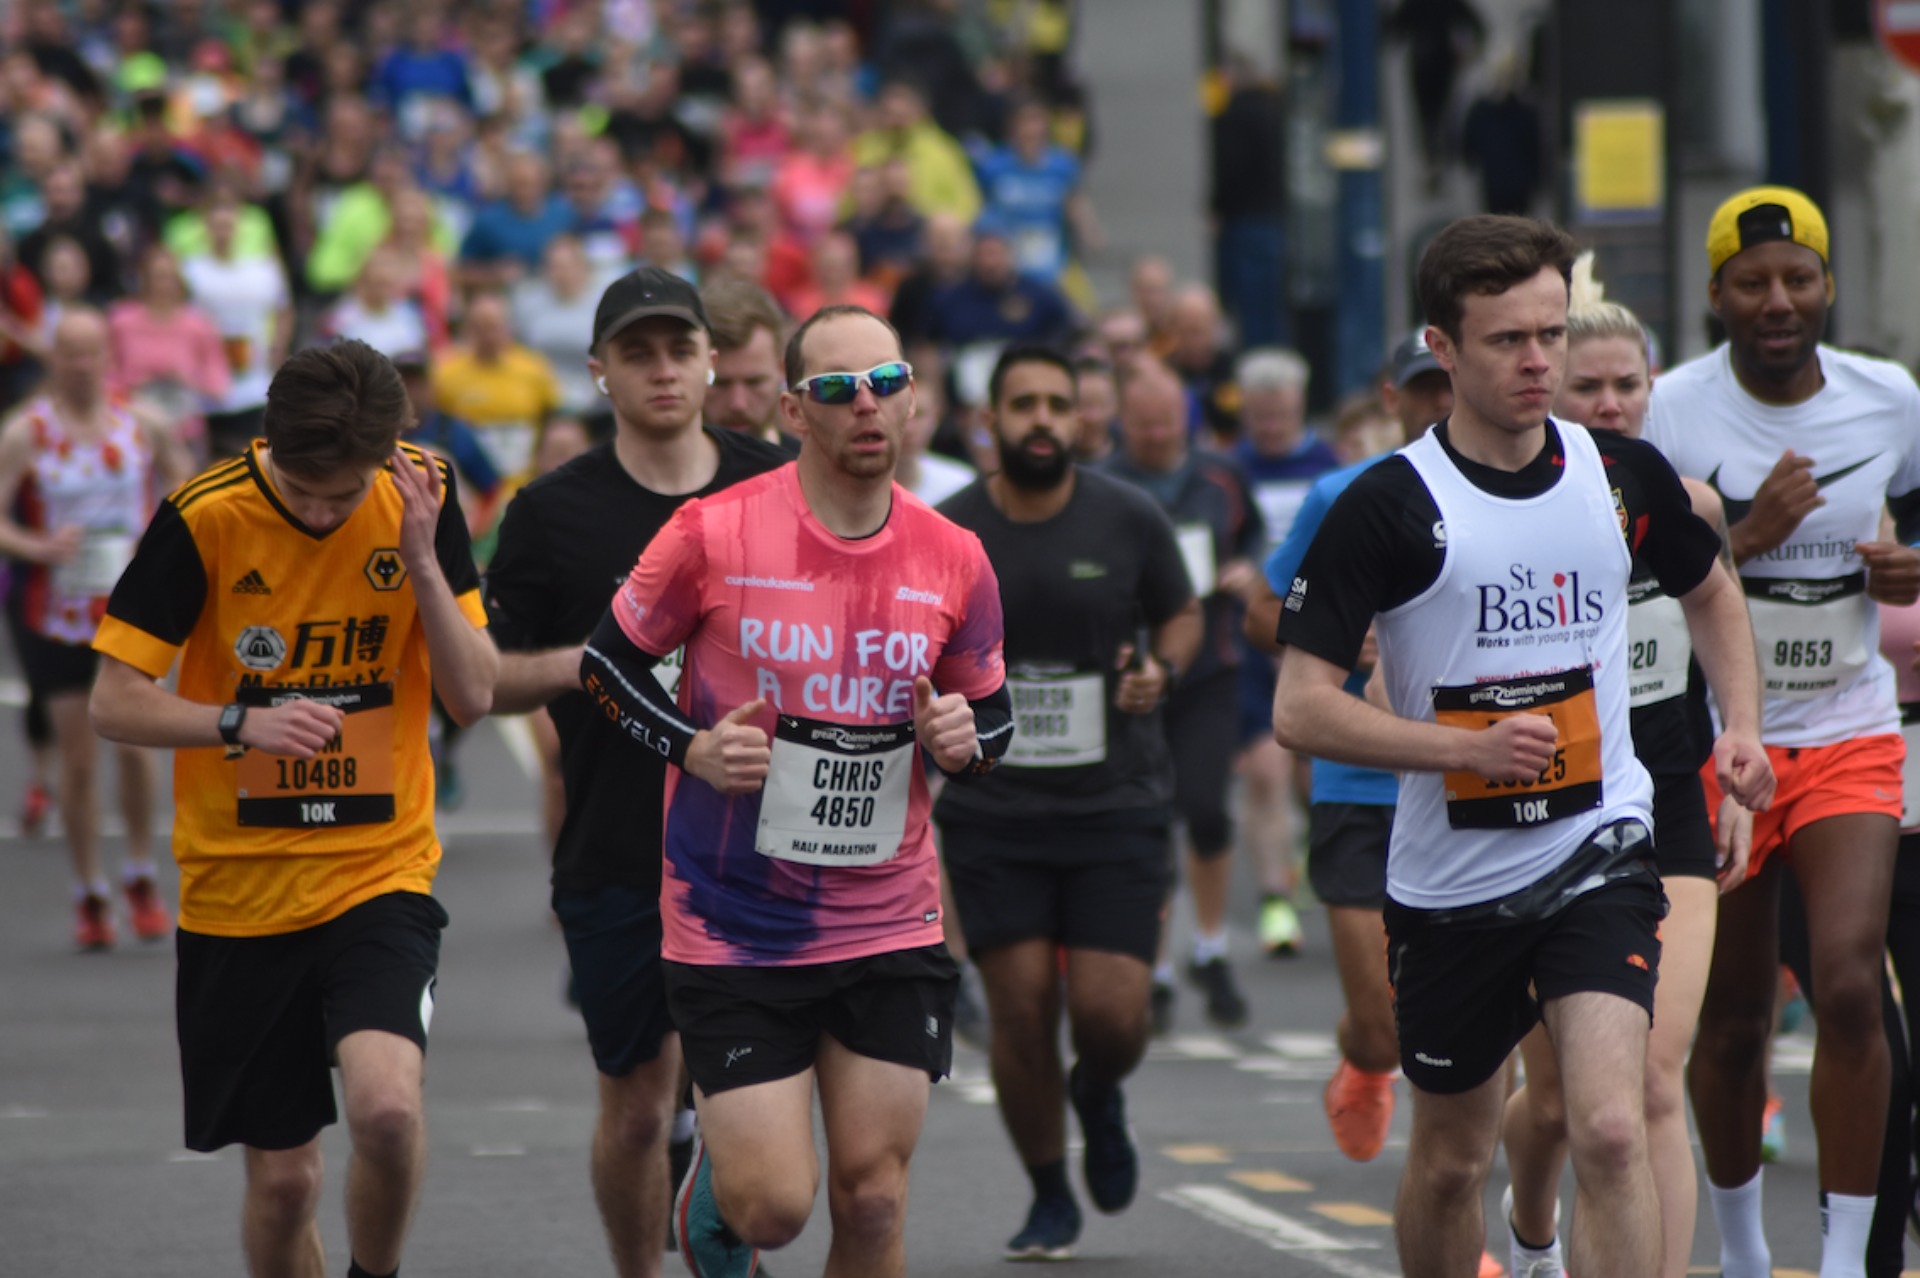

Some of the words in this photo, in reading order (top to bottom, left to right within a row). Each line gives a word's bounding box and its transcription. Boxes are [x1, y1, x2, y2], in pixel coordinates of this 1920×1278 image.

[231, 585, 272, 595] adidas
[725, 575, 814, 591] cureleukaemia
[1508, 563, 1537, 591] St
[1475, 570, 1604, 634] Basils
[290, 615, 390, 669] 万博
[740, 618, 834, 663] RUN
[855, 629, 930, 676] FOR
[1477, 636, 1510, 648] Works
[1513, 634, 1534, 647] with
[1537, 629, 1570, 647] young
[1774, 639, 1833, 667] 9653
[756, 667, 782, 711] A
[802, 673, 914, 719] CURE
[1469, 688, 1495, 704] great
[1502, 681, 1565, 699] birmingham
[276, 757, 357, 789] 10488
[813, 758, 884, 792] CHRIS
[301, 803, 337, 823] 10K
[811, 795, 875, 828] 4850
[1513, 799, 1550, 823] 10K
[792, 839, 819, 854] HALF
[821, 843, 878, 856] MARATHON
